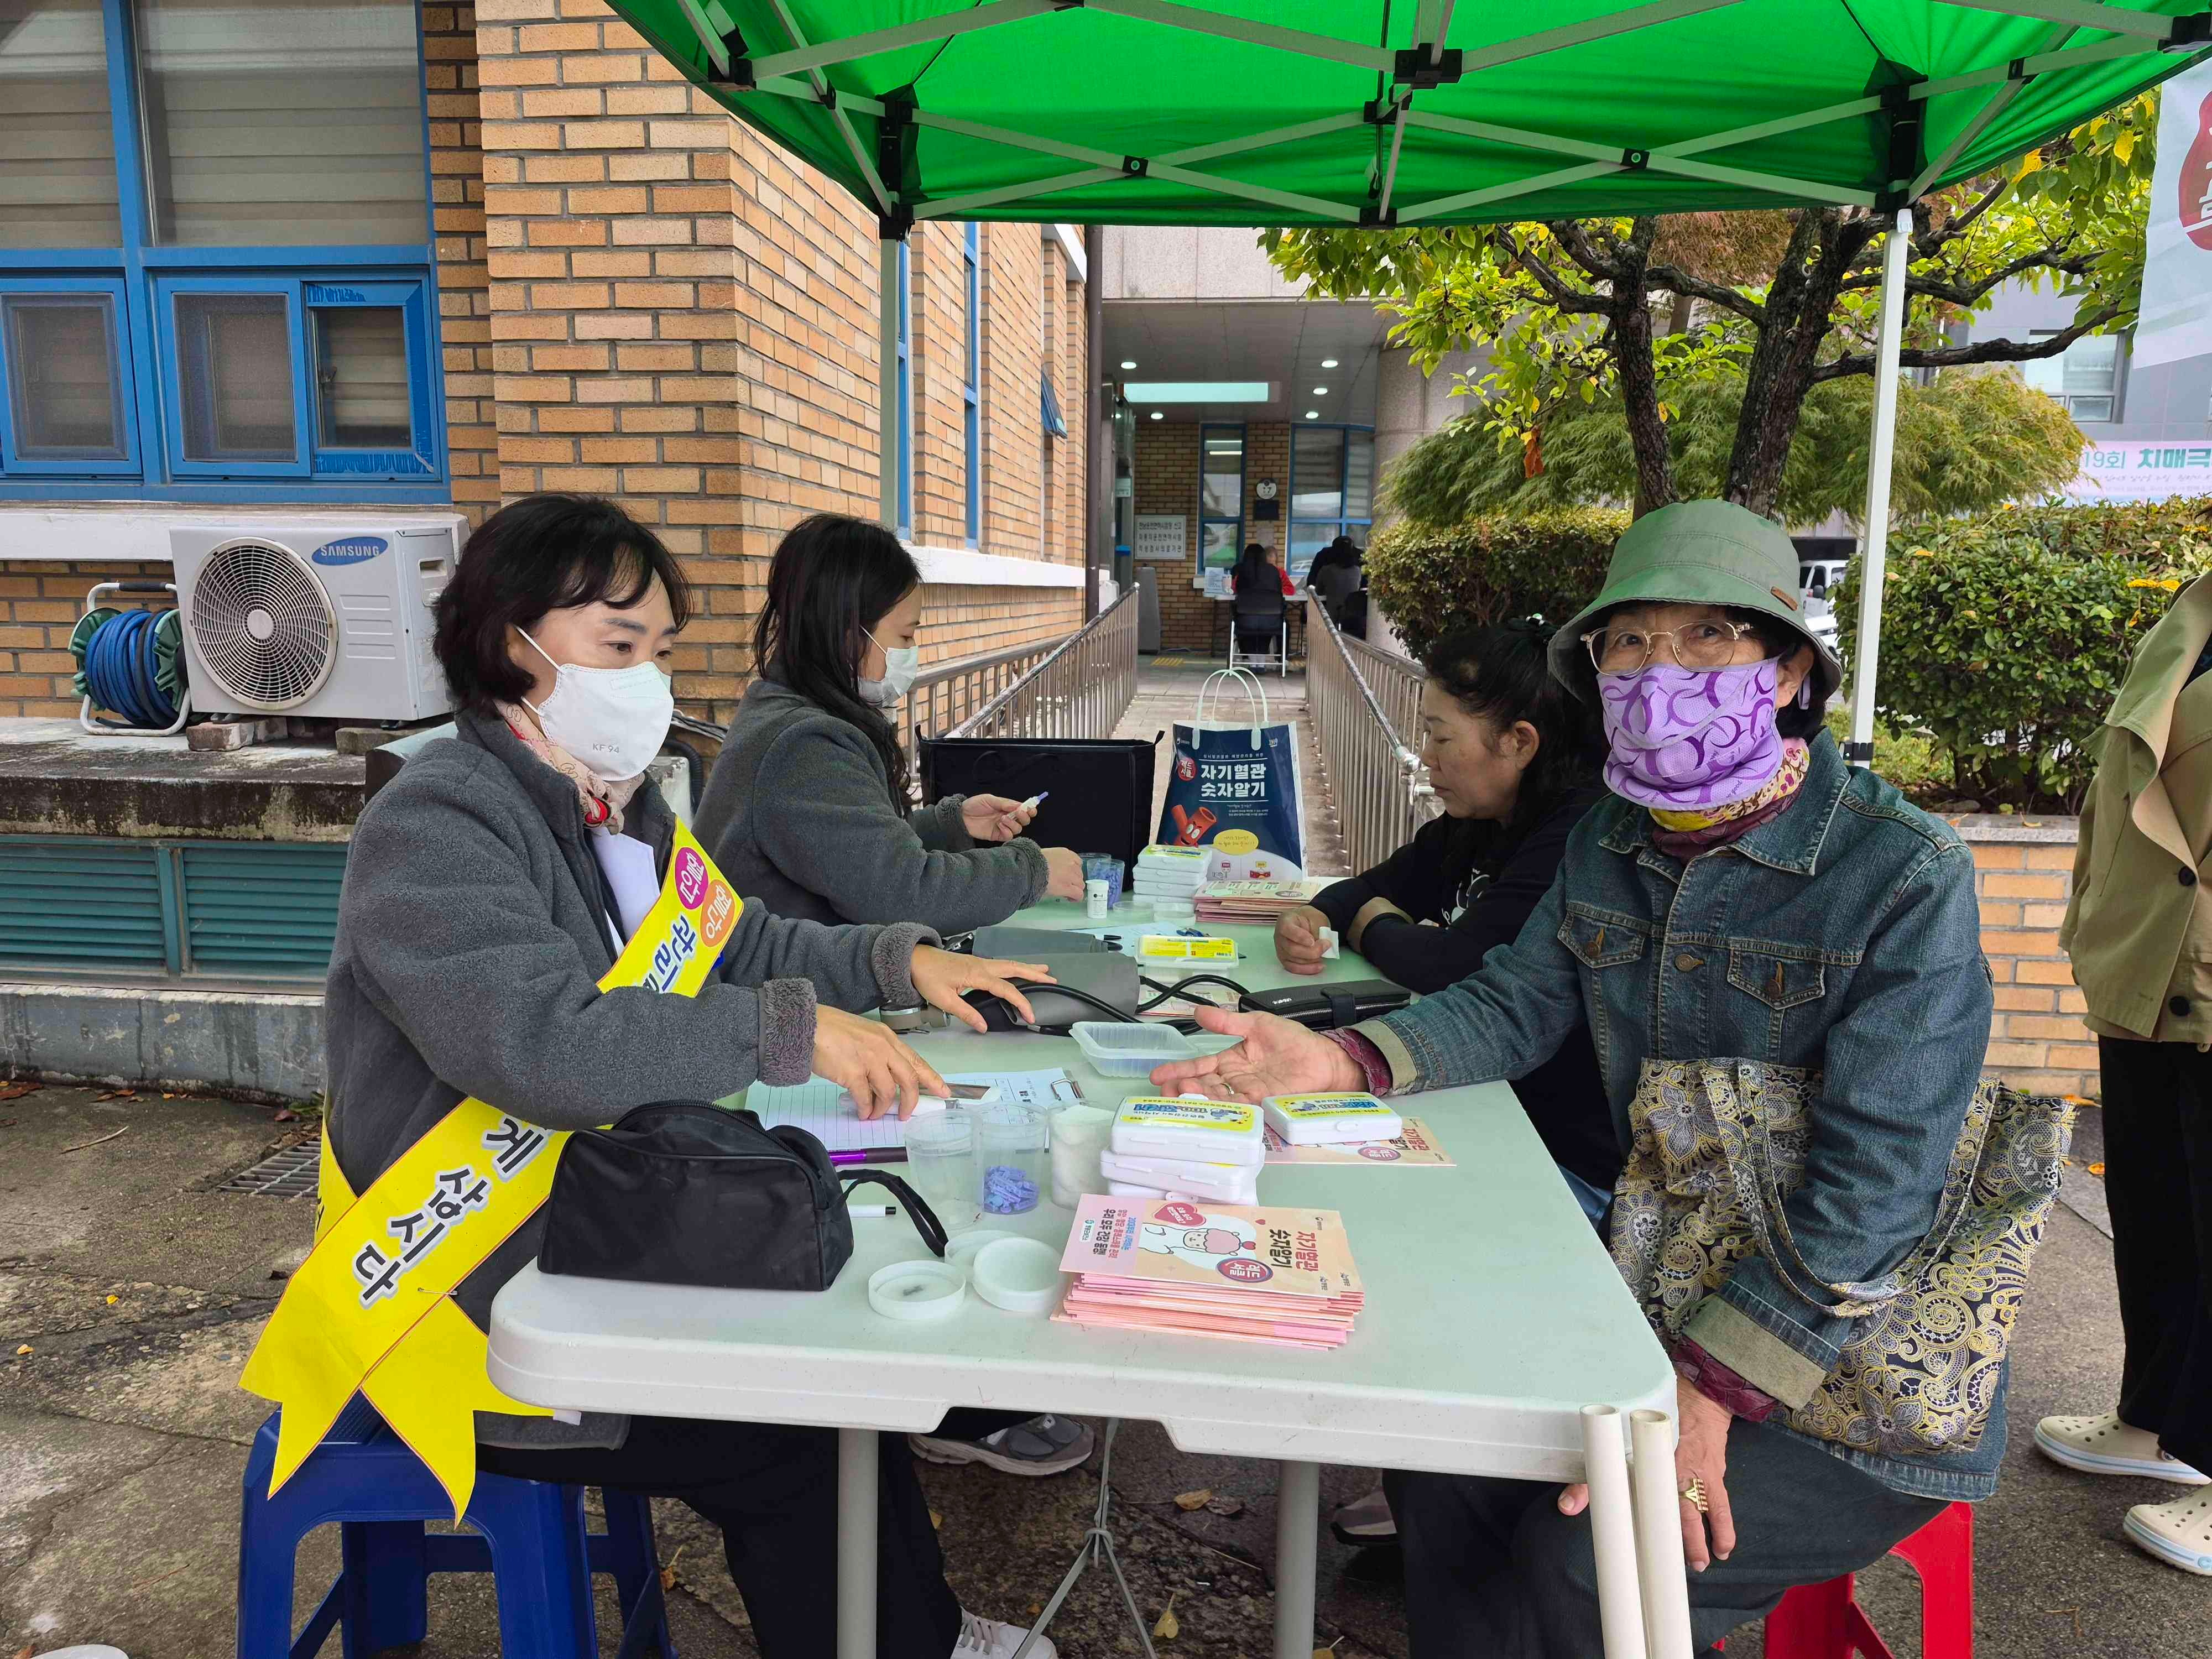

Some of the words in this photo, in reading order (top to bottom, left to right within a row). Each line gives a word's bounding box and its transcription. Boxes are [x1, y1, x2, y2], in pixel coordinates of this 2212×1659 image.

[2137, 448, 2212, 469] 치매극
[320, 545, 380, 558] SAMSUNG
[1201, 763, 1267, 780] 자기혈관
[1201, 781, 1266, 797] 숫자알기
[680, 851, 705, 904] 혈압
[705, 884, 733, 940] 혈당
[1389, 1136, 1411, 1150] 알기
[1102, 1208, 1117, 1219] 우리
[1098, 1219, 1113, 1231] 모두
[354, 1167, 490, 1303] 삽시다
[1096, 1231, 1111, 1243] 건강
[1269, 1228, 1293, 1269] 숫자알기
[1295, 1230, 1319, 1272] 자기혈관
[1229, 1262, 1245, 1277] 서클
[1246, 1263, 1261, 1278] 레드
